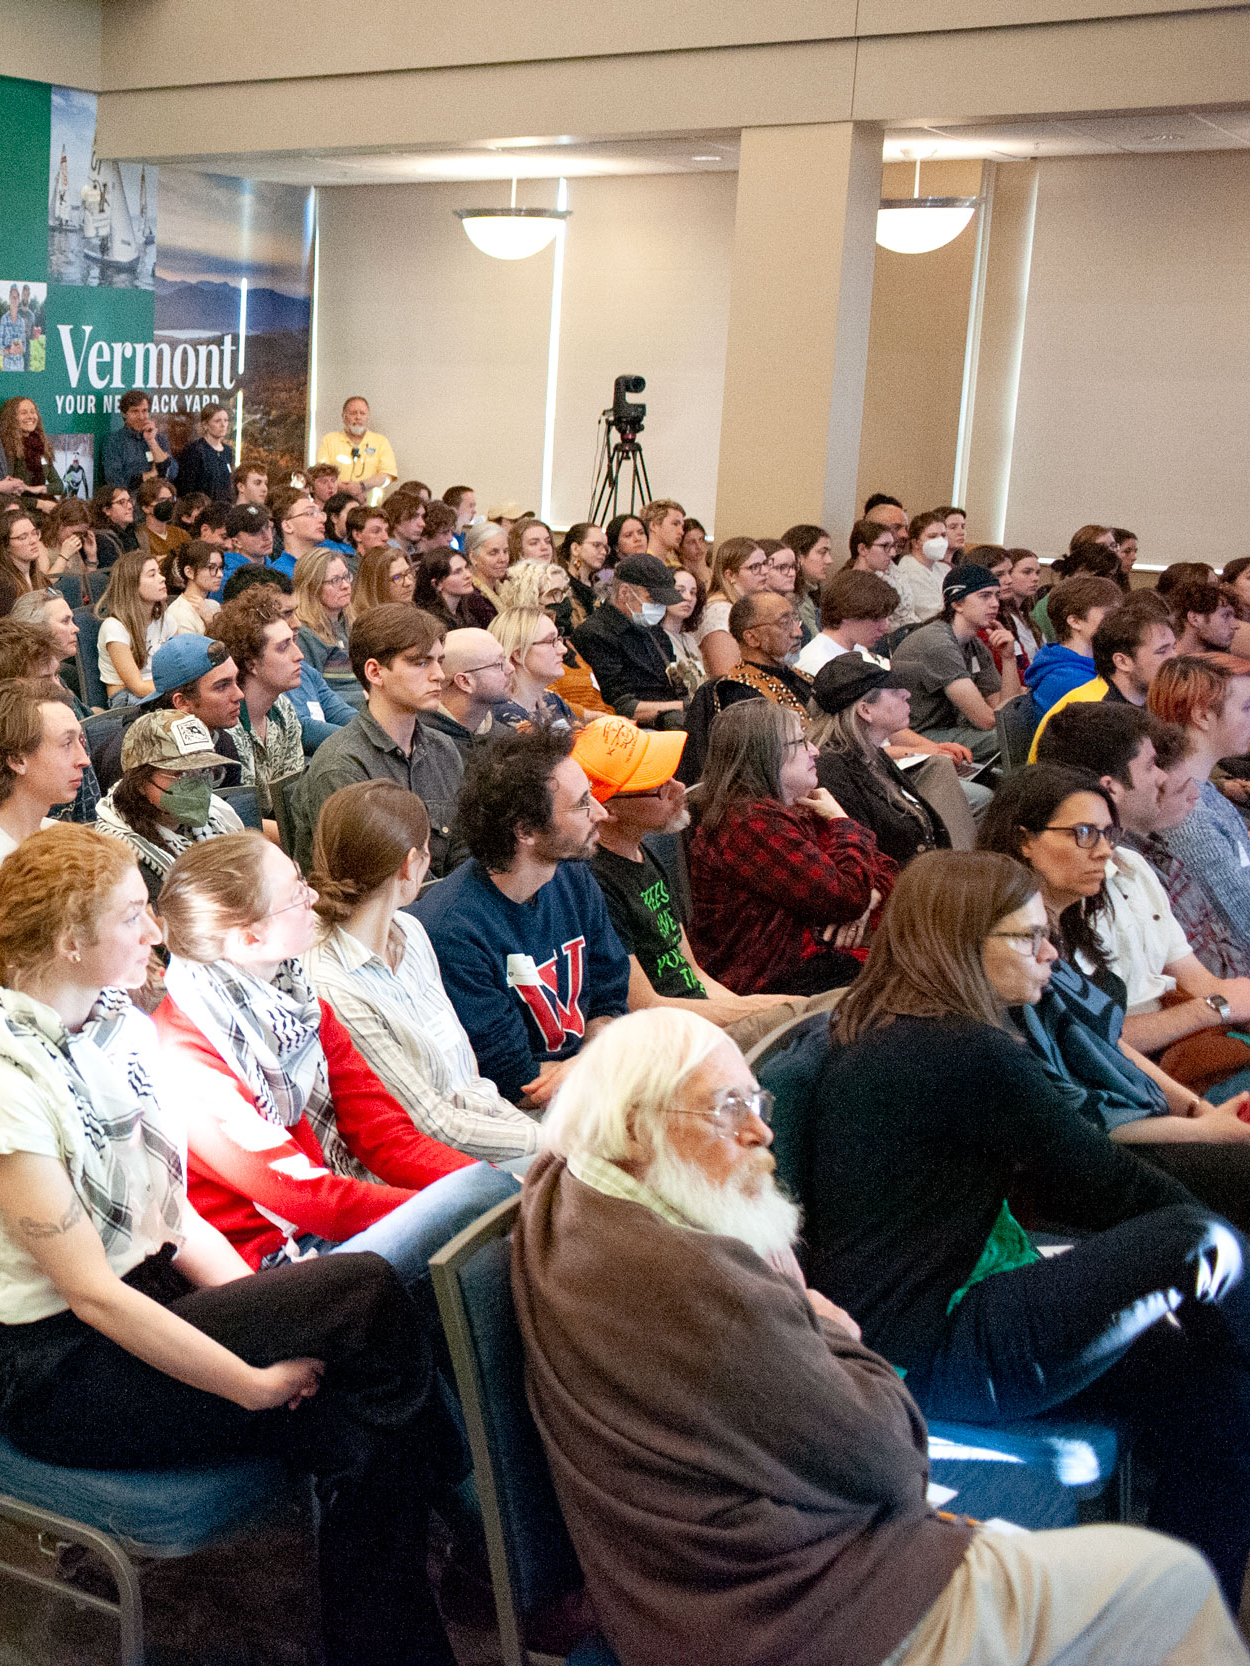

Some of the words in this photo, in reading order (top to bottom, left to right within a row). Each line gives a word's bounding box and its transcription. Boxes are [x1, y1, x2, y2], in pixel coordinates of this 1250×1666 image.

[56, 324, 237, 389] Vermont
[55, 395, 97, 414] YOUR
[103, 395, 121, 414] NE
[151, 394, 178, 413] ACK
[512, 934, 586, 1052] W
